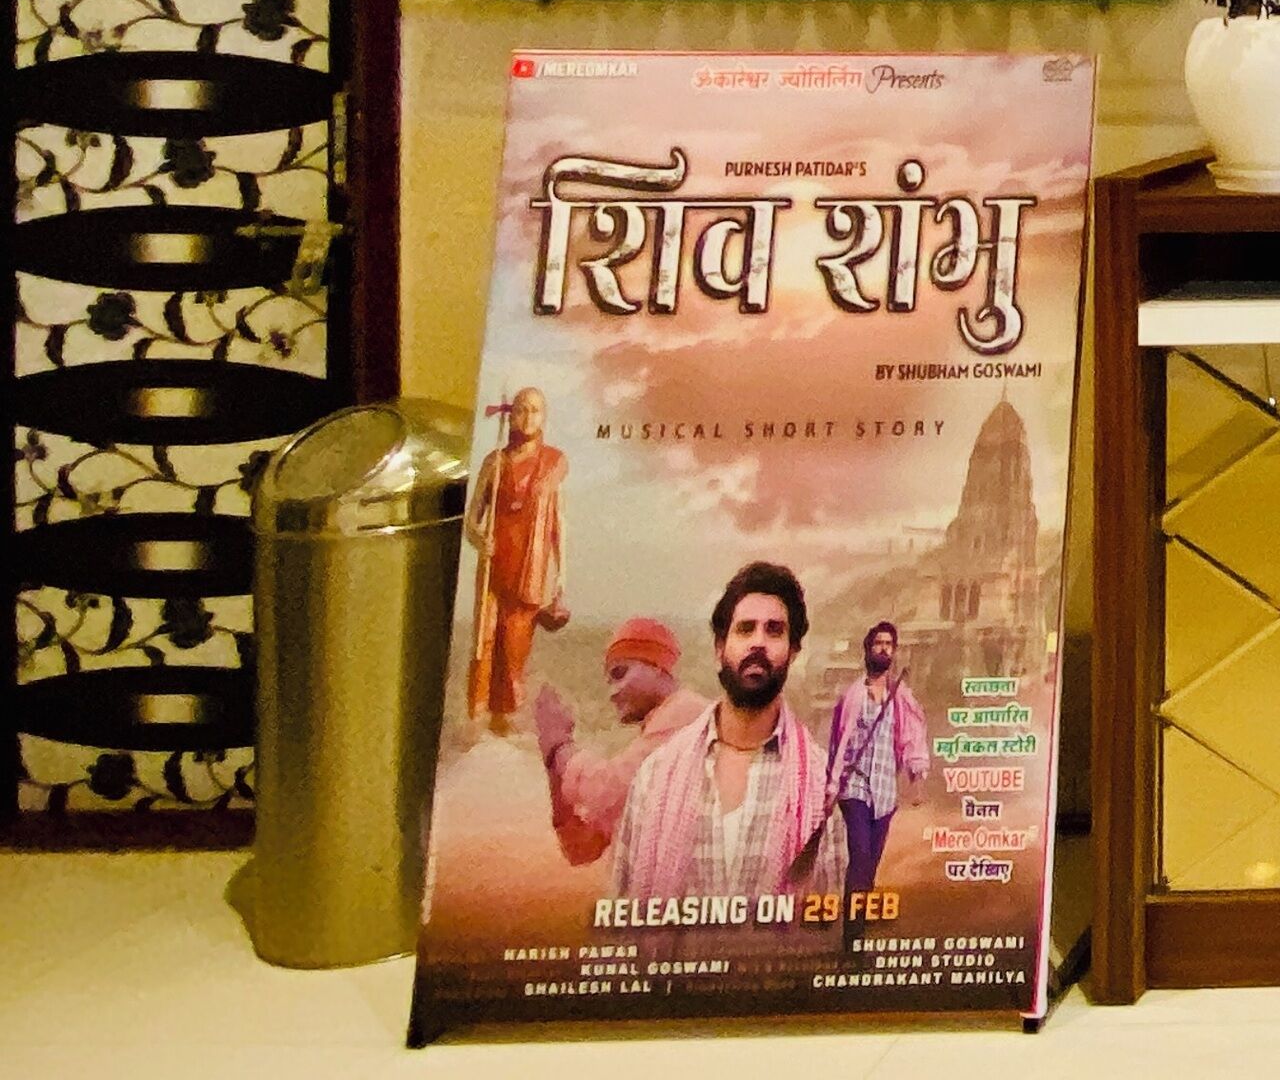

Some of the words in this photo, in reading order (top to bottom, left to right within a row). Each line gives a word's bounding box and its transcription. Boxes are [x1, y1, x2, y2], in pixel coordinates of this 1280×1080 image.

[865, 65, 945, 94] Presents
[725, 161, 792, 176] PURNESH
[795, 161, 867, 176] PATIDAR'S
[528, 147, 791, 314] शिव
[815, 159, 1037, 354] शंभु
[875, 364, 894, 380] BY
[898, 363, 969, 380] SHUBHAM
[973, 362, 1042, 378] GOSWAMI
[596, 422, 724, 440] MUSICAL
[744, 421, 838, 439] SHORT
[855, 420, 946, 438] STORY
[950, 710, 969, 724] पर
[1002, 734, 1036, 753] स्टोरी
[945, 770, 1023, 789] YOUTUBE
[948, 863, 966, 877] पर
[594, 896, 748, 928] RELEASING
[756, 894, 795, 924] ON
[803, 893, 840, 923] 29
[849, 892, 901, 921] FEB
[852, 938, 937, 953] SHUBHAM
[943, 936, 1025, 951] GOSWAMI
[647, 961, 730, 975] GOSWAMI
[931, 954, 995, 968] STUDIO
[620, 980, 652, 994] LAL
[812, 972, 943, 989] CHANDRAKANT
